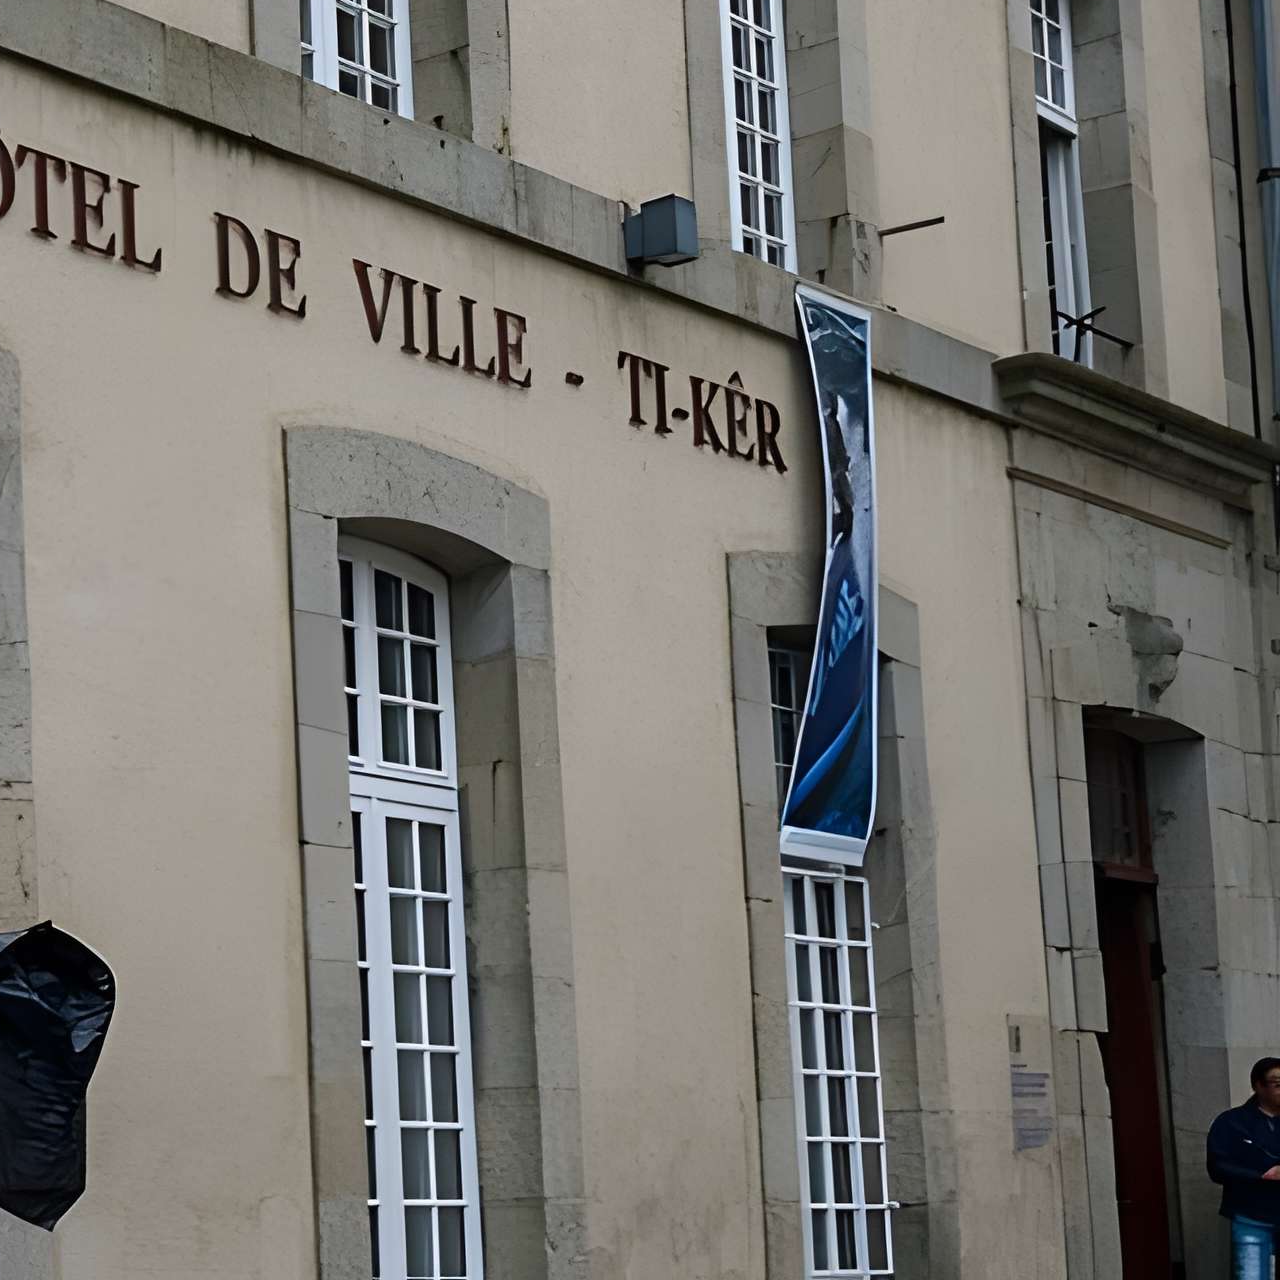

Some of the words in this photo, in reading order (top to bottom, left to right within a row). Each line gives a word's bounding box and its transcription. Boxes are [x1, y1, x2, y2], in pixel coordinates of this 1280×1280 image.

[213, 211, 307, 319] DE
[351, 257, 532, 388] VILLE
[617, 350, 788, 475] TI-KÊR
